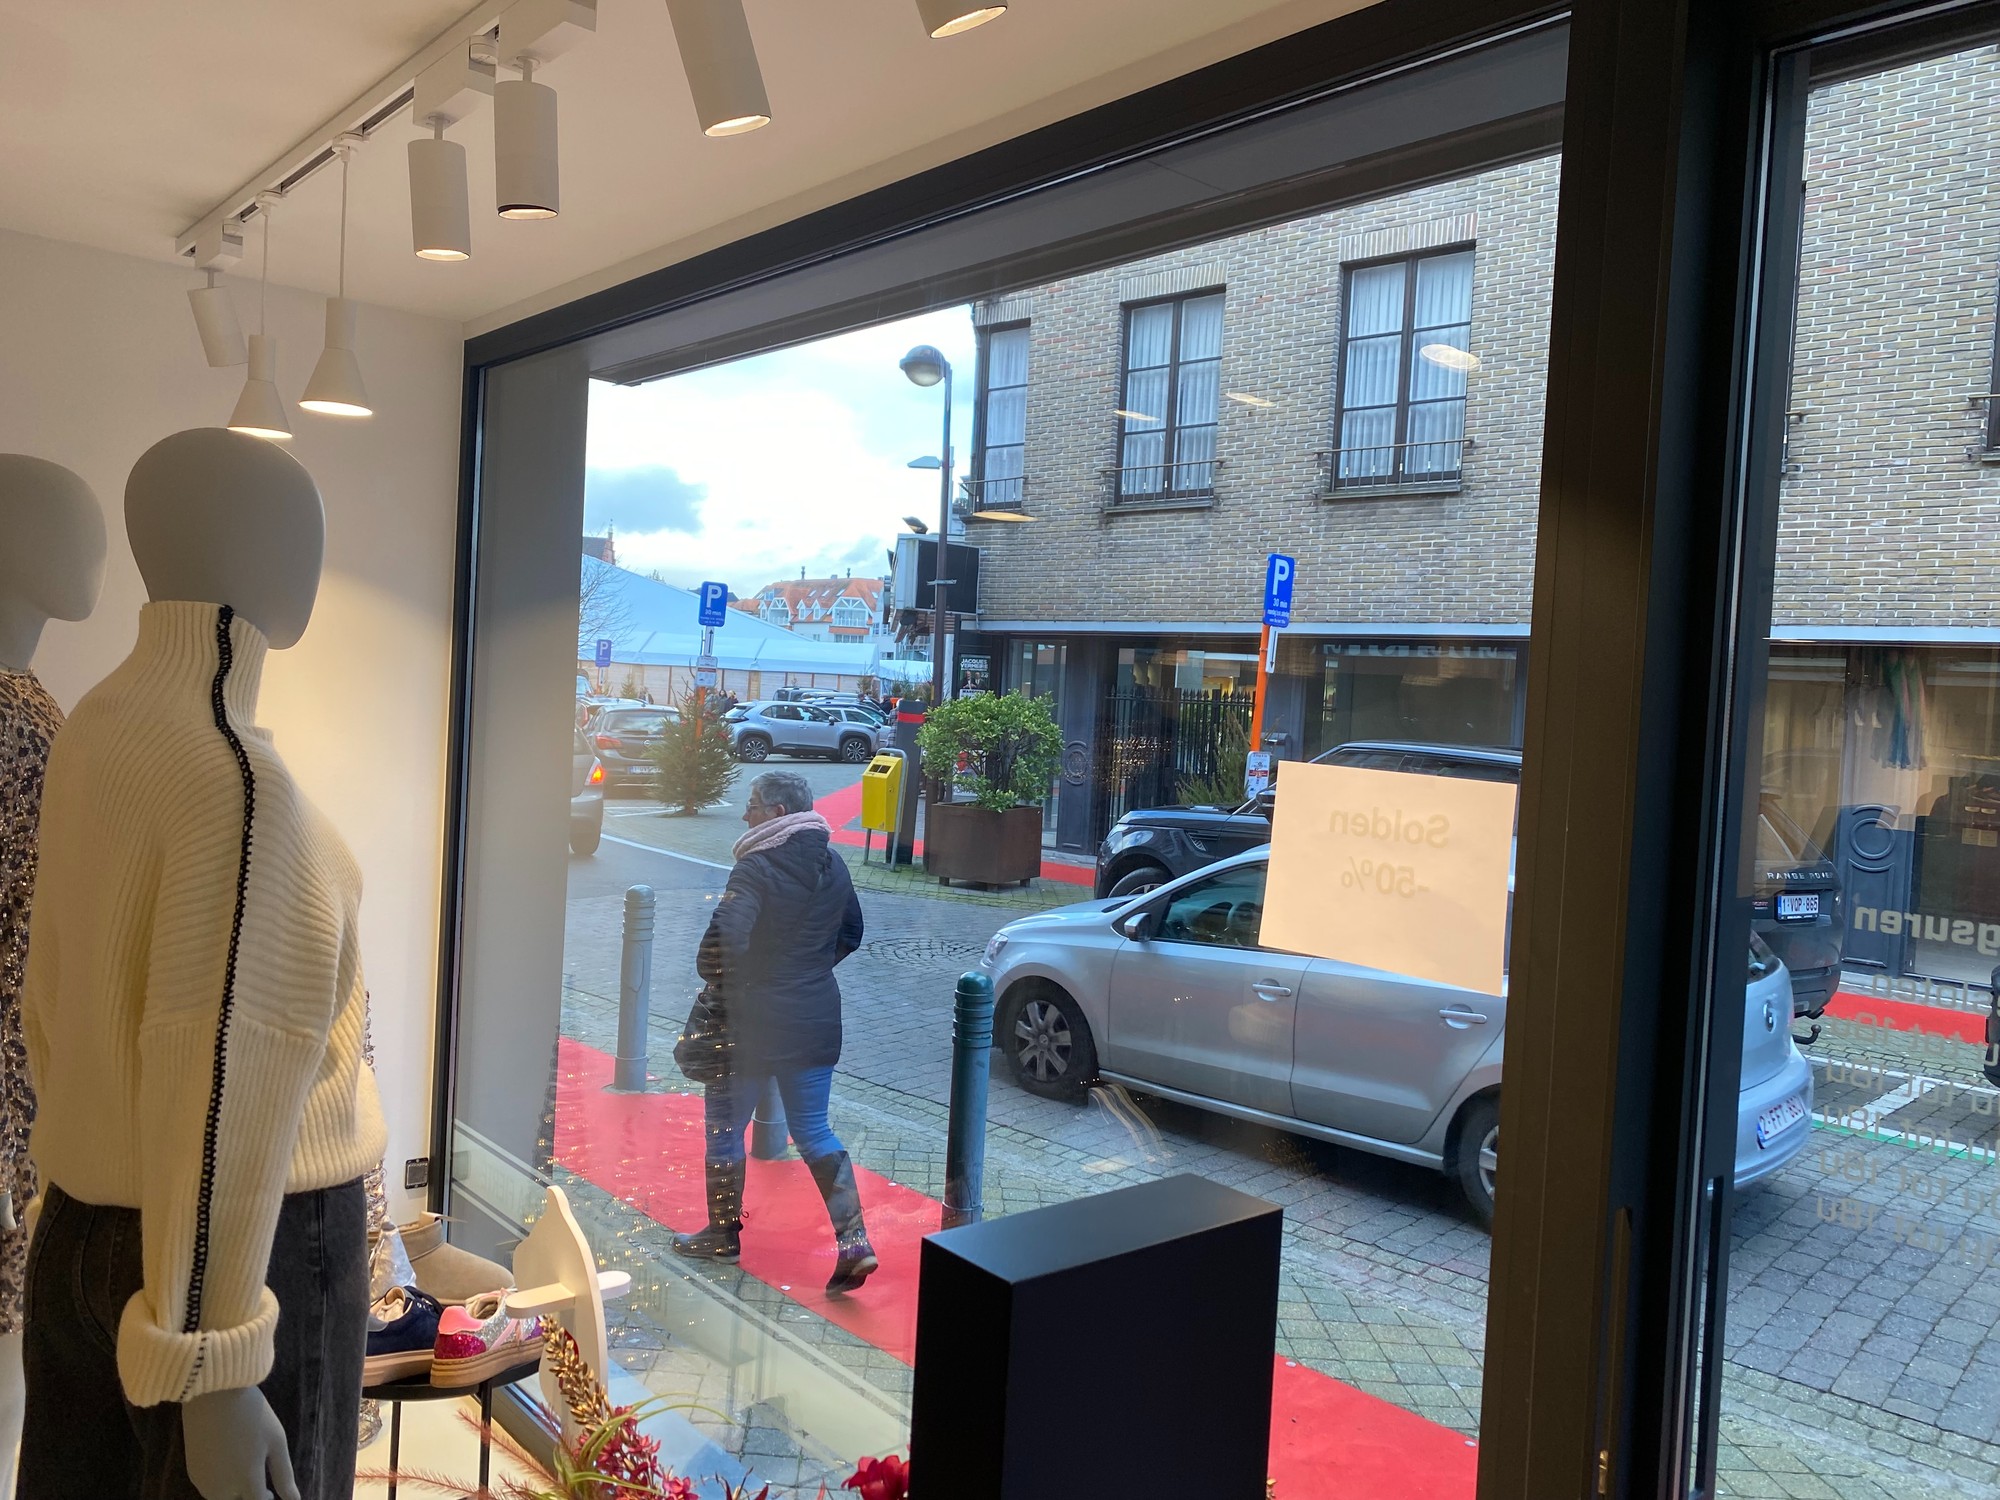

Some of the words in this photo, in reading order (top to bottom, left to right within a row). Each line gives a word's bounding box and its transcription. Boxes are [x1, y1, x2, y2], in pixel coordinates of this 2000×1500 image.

[1272, 558, 1290, 596] P
[706, 584, 723, 608] P
[1273, 598, 1280, 607] 30
[1279, 599, 1288, 609] min
[599, 640, 609, 656] P
[1766, 871, 1805, 880] RANGE
